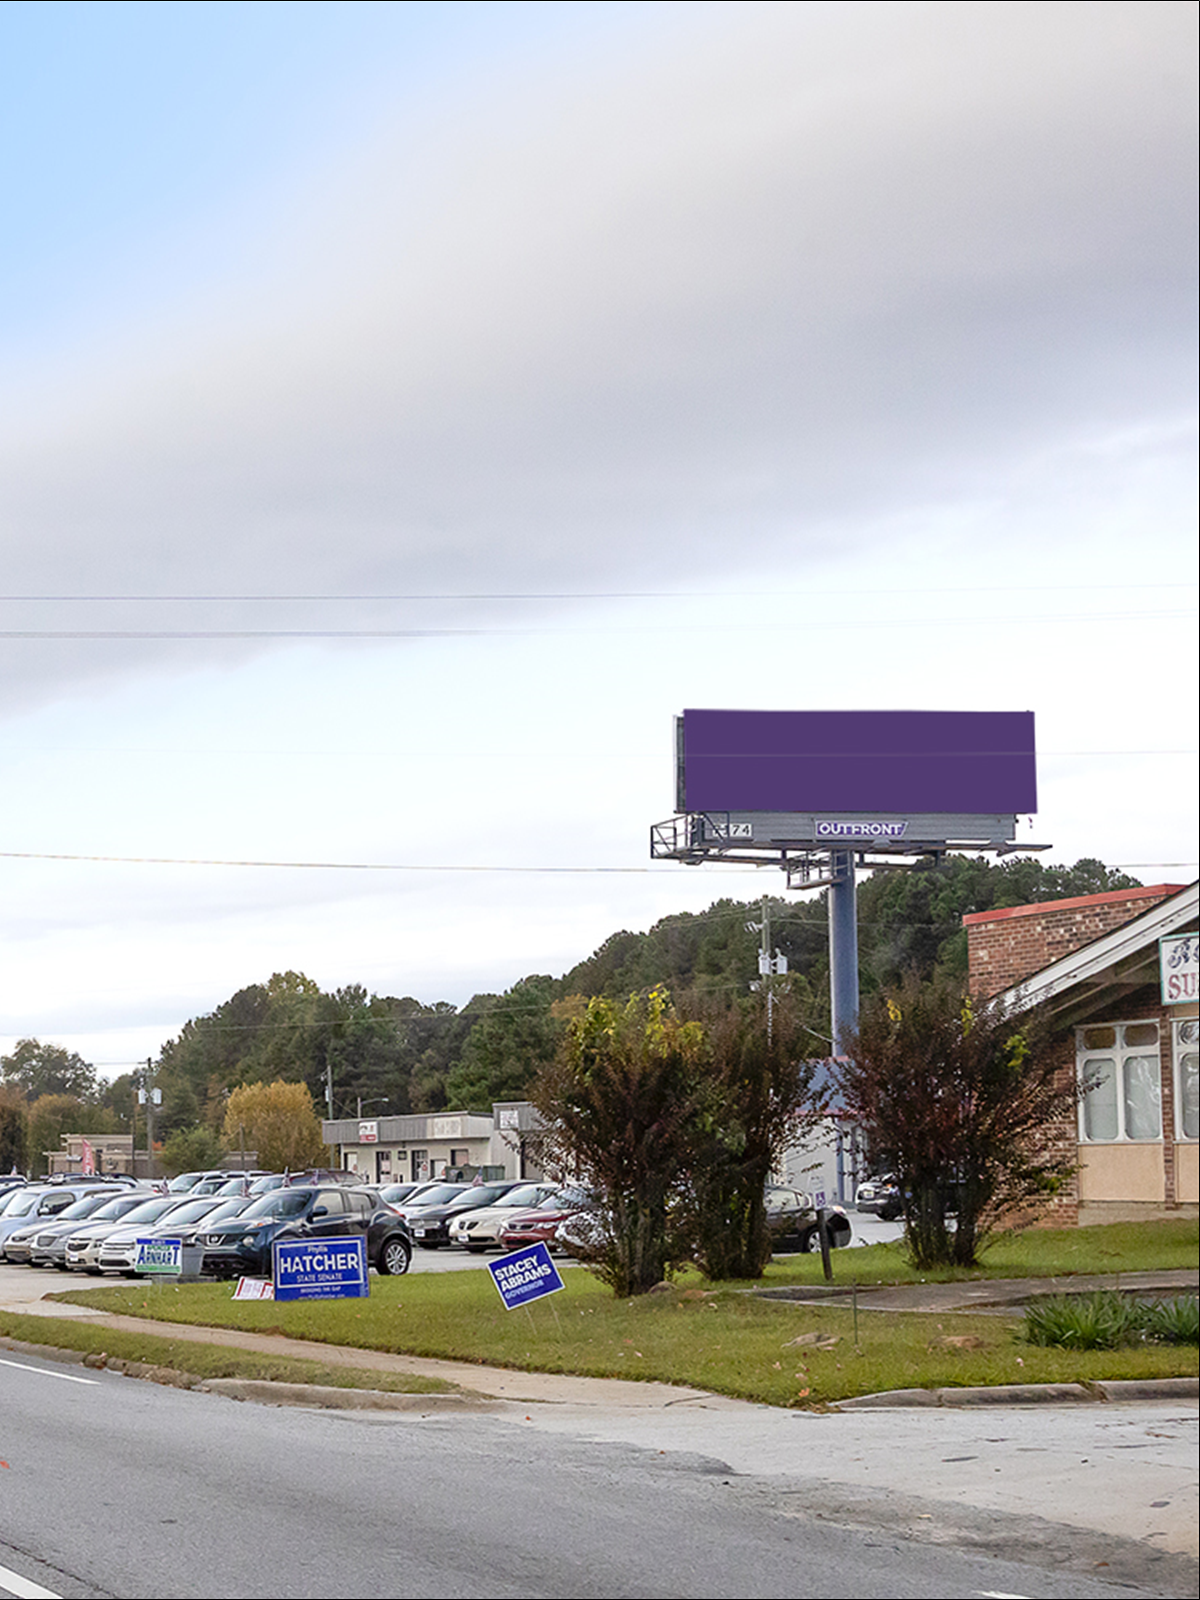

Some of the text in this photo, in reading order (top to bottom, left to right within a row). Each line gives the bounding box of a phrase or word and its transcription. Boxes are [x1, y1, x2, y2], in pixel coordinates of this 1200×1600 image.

[819, 822, 902, 835] OUTFRONT
[1168, 973, 1199, 1000] SU
[137, 1245, 180, 1265] ARNHART
[280, 1253, 359, 1274] HATCHER
[296, 1273, 343, 1283] STATE SENATE
[494, 1255, 538, 1281] STACEY
[501, 1264, 552, 1292] ABRAMS
[504, 1279, 545, 1300] GOVERNOR
